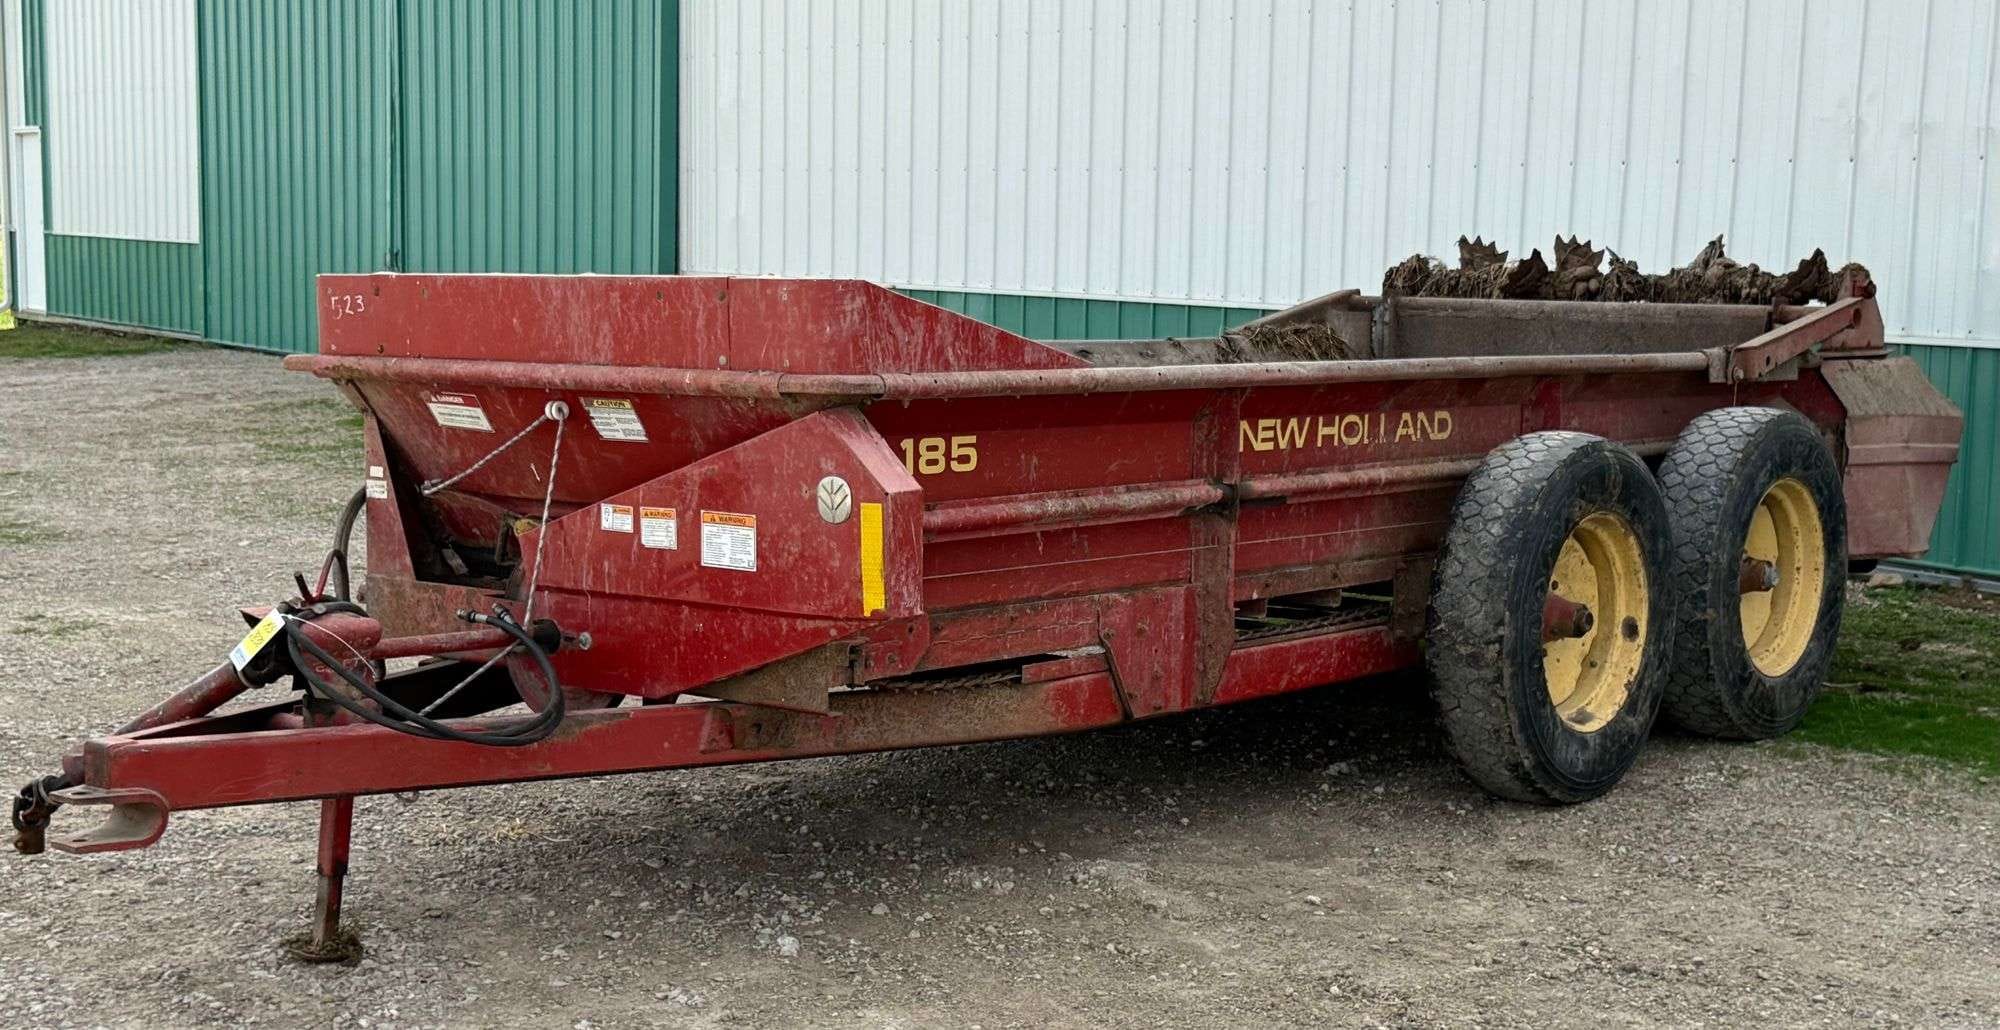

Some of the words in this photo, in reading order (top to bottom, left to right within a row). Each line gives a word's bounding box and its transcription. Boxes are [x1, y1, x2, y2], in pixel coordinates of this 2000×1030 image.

[331, 295, 365, 320] 523
[1239, 417, 1311, 452] NEW
[900, 435, 978, 475] 185
